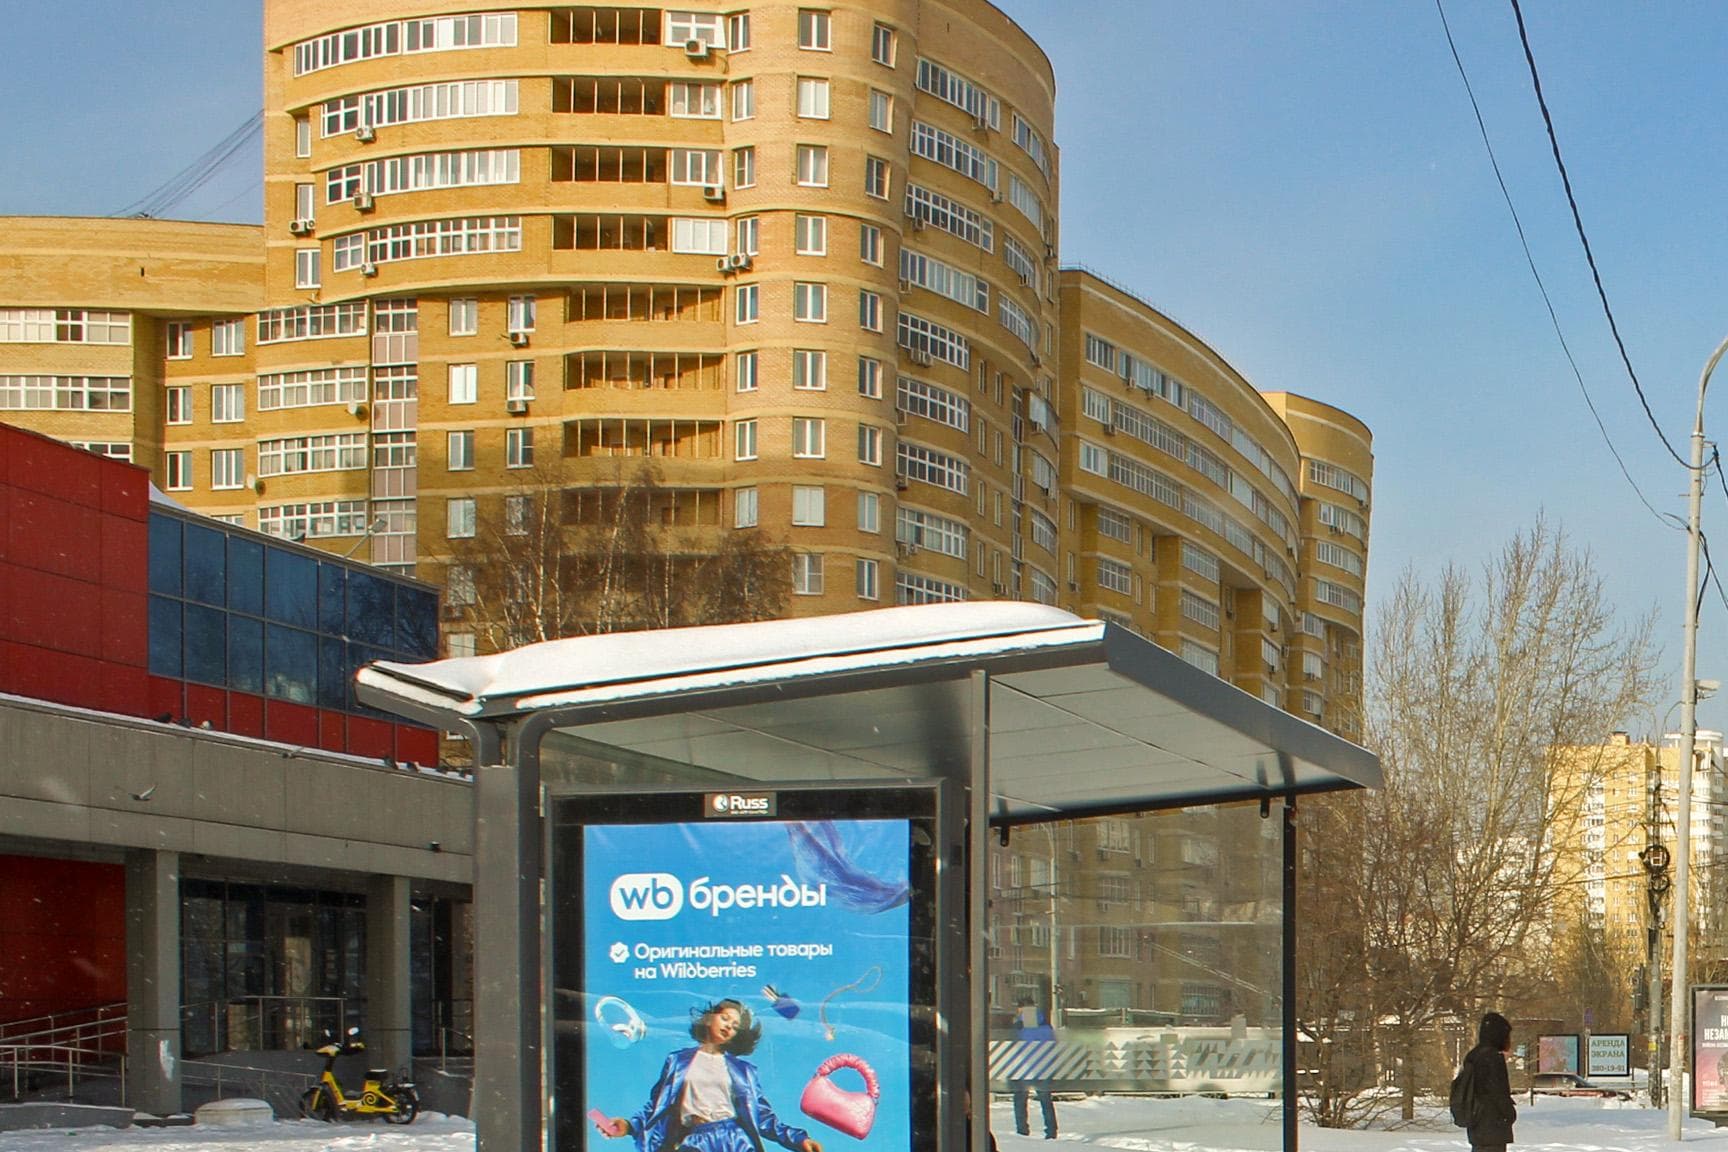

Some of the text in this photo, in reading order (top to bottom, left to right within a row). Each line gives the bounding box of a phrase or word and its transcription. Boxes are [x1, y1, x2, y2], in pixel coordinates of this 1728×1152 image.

[730, 795, 769, 810] Russ
[619, 874, 827, 917] wb бренды
[634, 942, 833, 963] Оригинальные товары
[634, 961, 757, 980] на Wildberries
